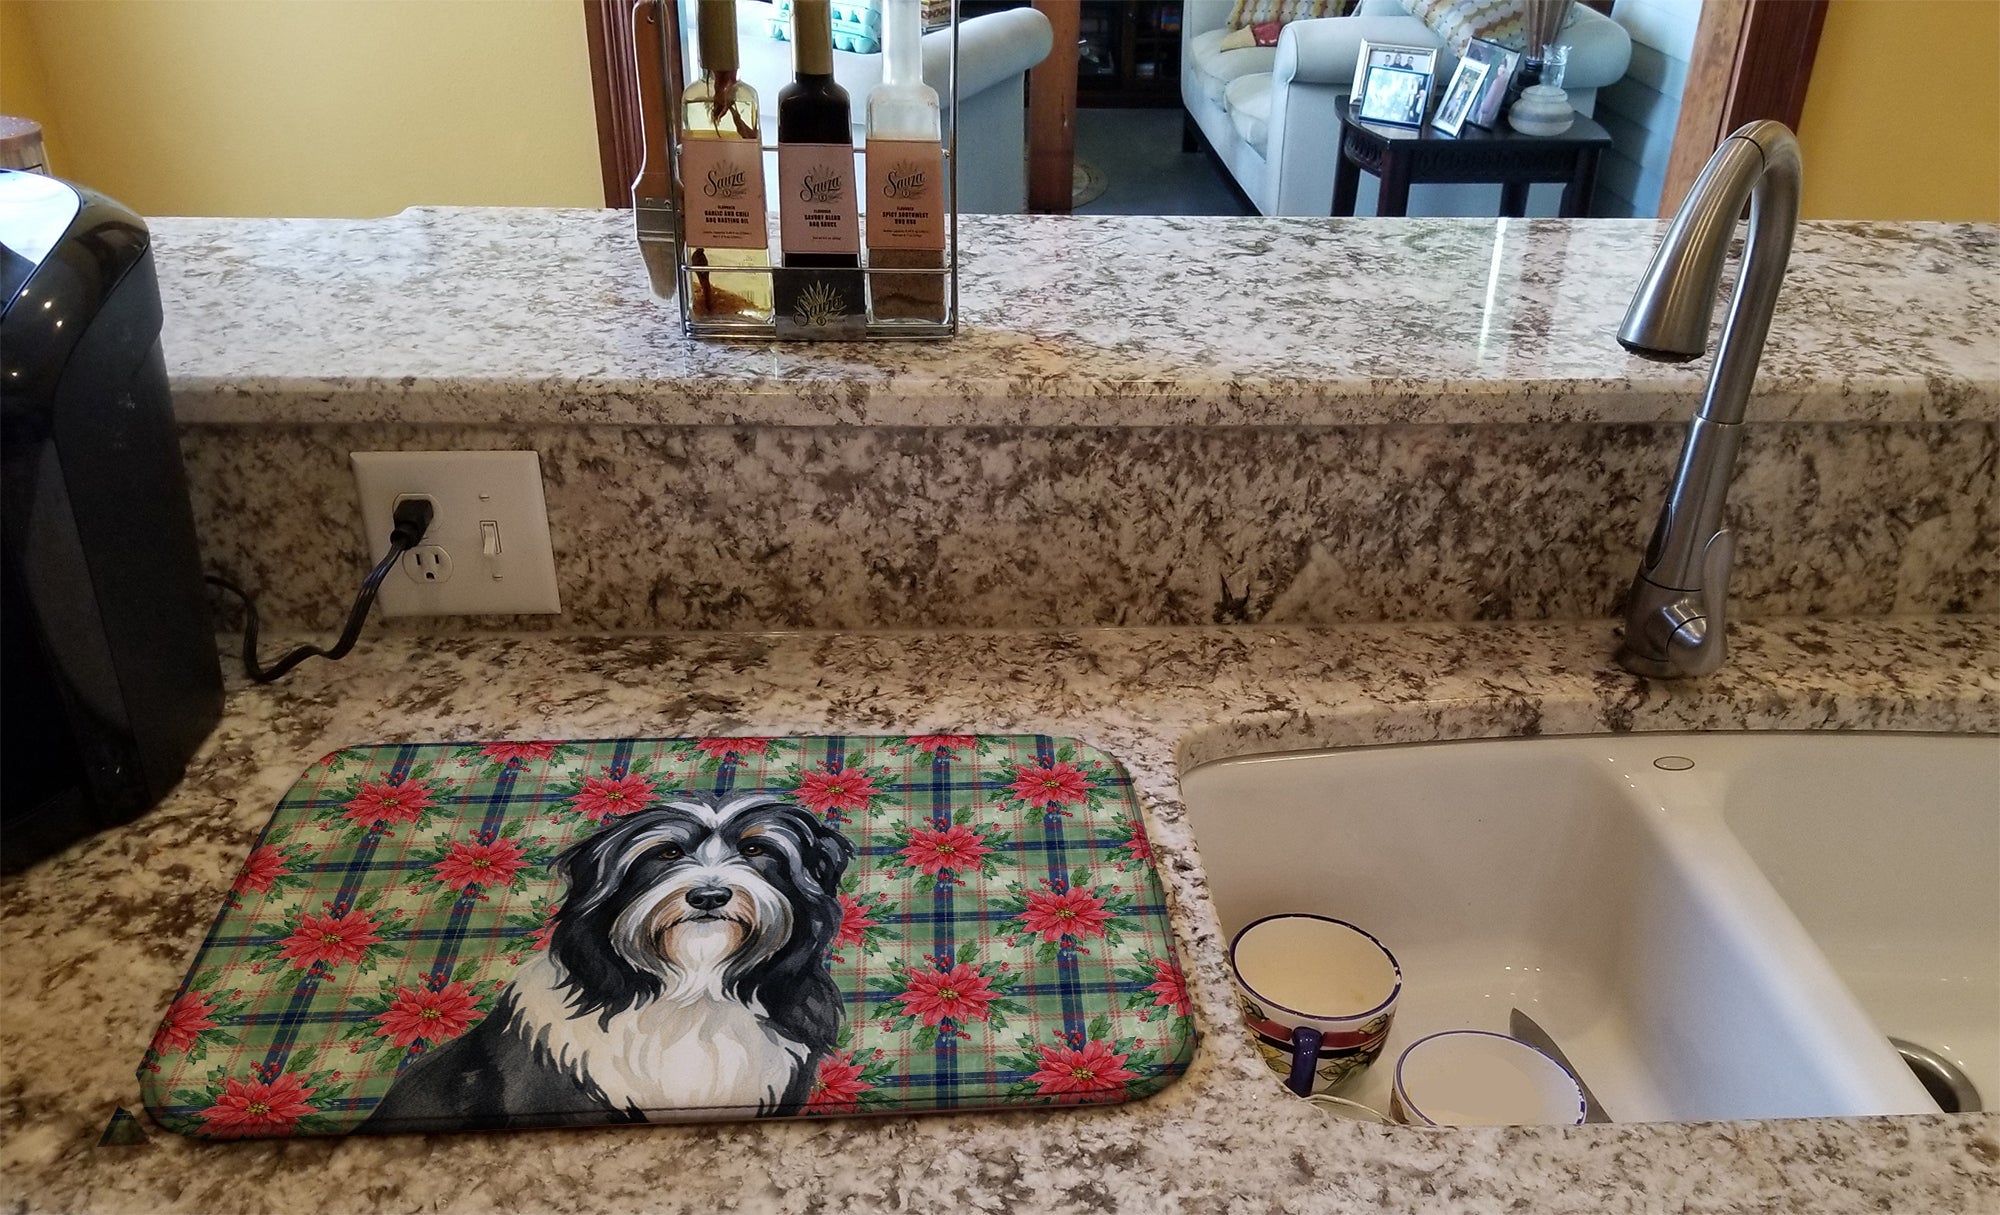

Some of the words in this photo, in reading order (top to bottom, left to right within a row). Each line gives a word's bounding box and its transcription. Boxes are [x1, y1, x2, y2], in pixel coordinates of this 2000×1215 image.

[704, 170, 745, 197] Sauza
[800, 175, 842, 202] Sauza
[884, 171, 925, 198] Sauza
